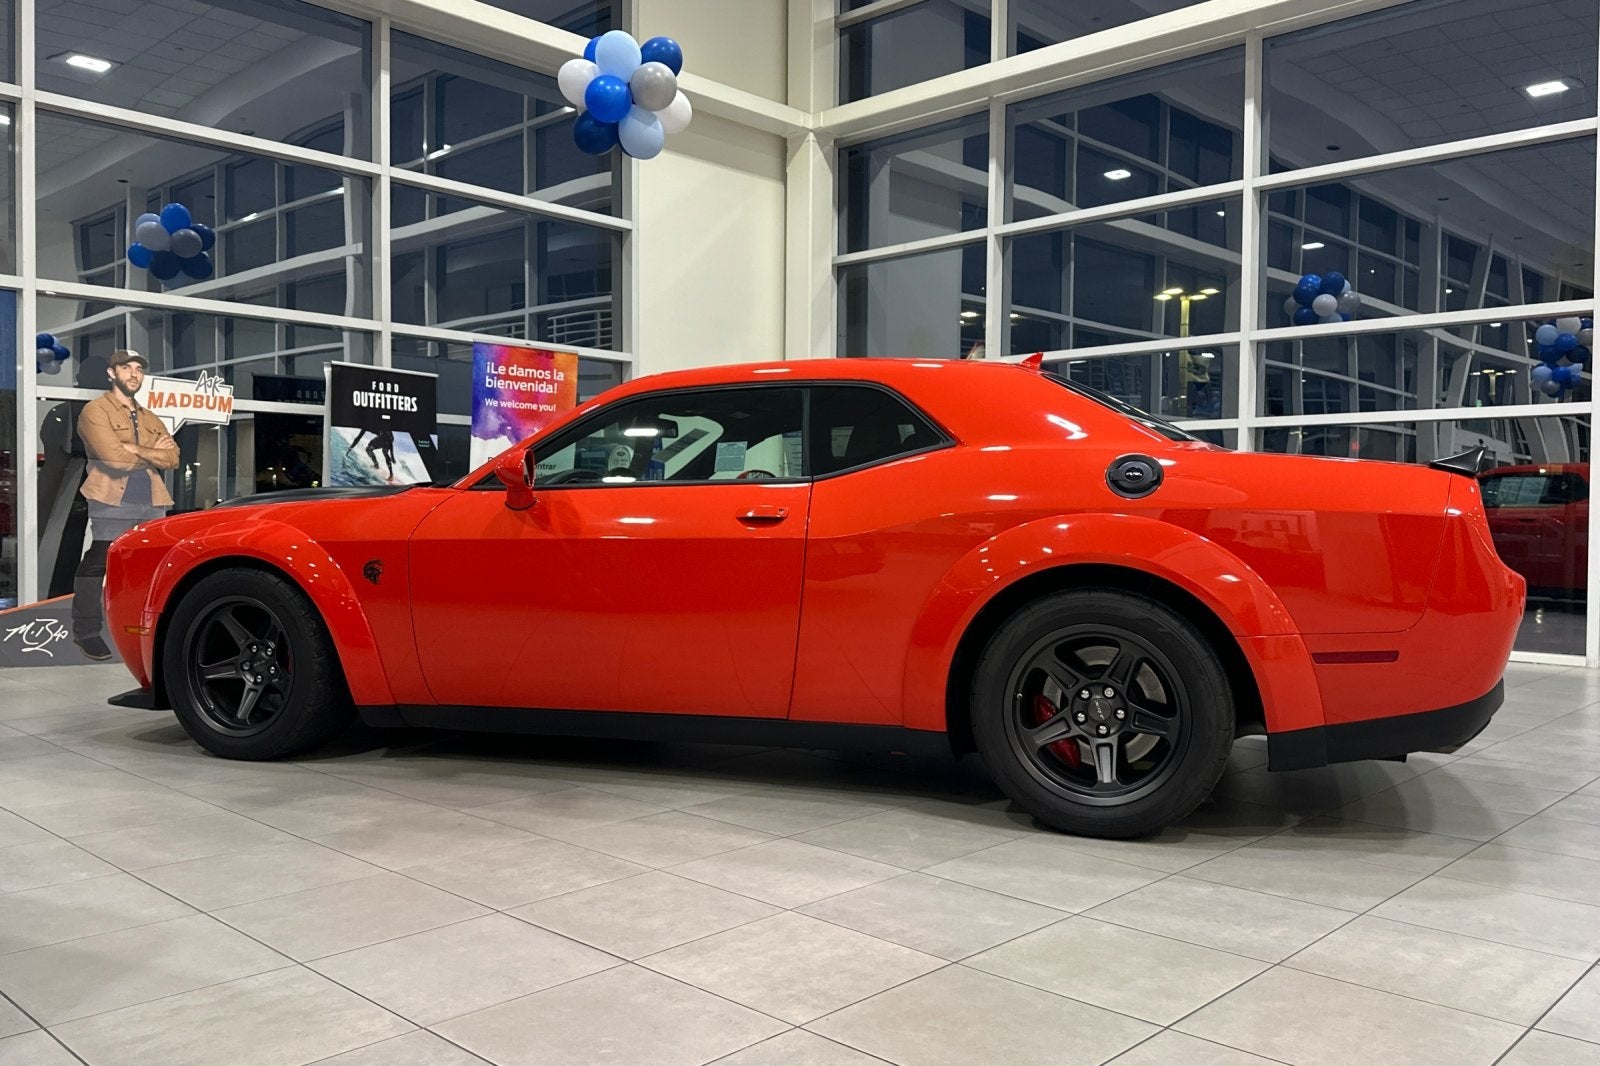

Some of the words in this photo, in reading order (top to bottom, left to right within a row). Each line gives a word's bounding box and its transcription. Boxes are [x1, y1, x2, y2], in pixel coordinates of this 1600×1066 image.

[508, 364, 551, 379] damos
[553, 368, 565, 381] la
[371, 381, 400, 392] FORD
[485, 376, 558, 394] bienvenida!
[147, 391, 233, 414] MADBUM
[353, 390, 418, 413] OUTFITTERS
[485, 397, 499, 407] We
[499, 399, 538, 411] welcome
[538, 403, 557, 412] you!
